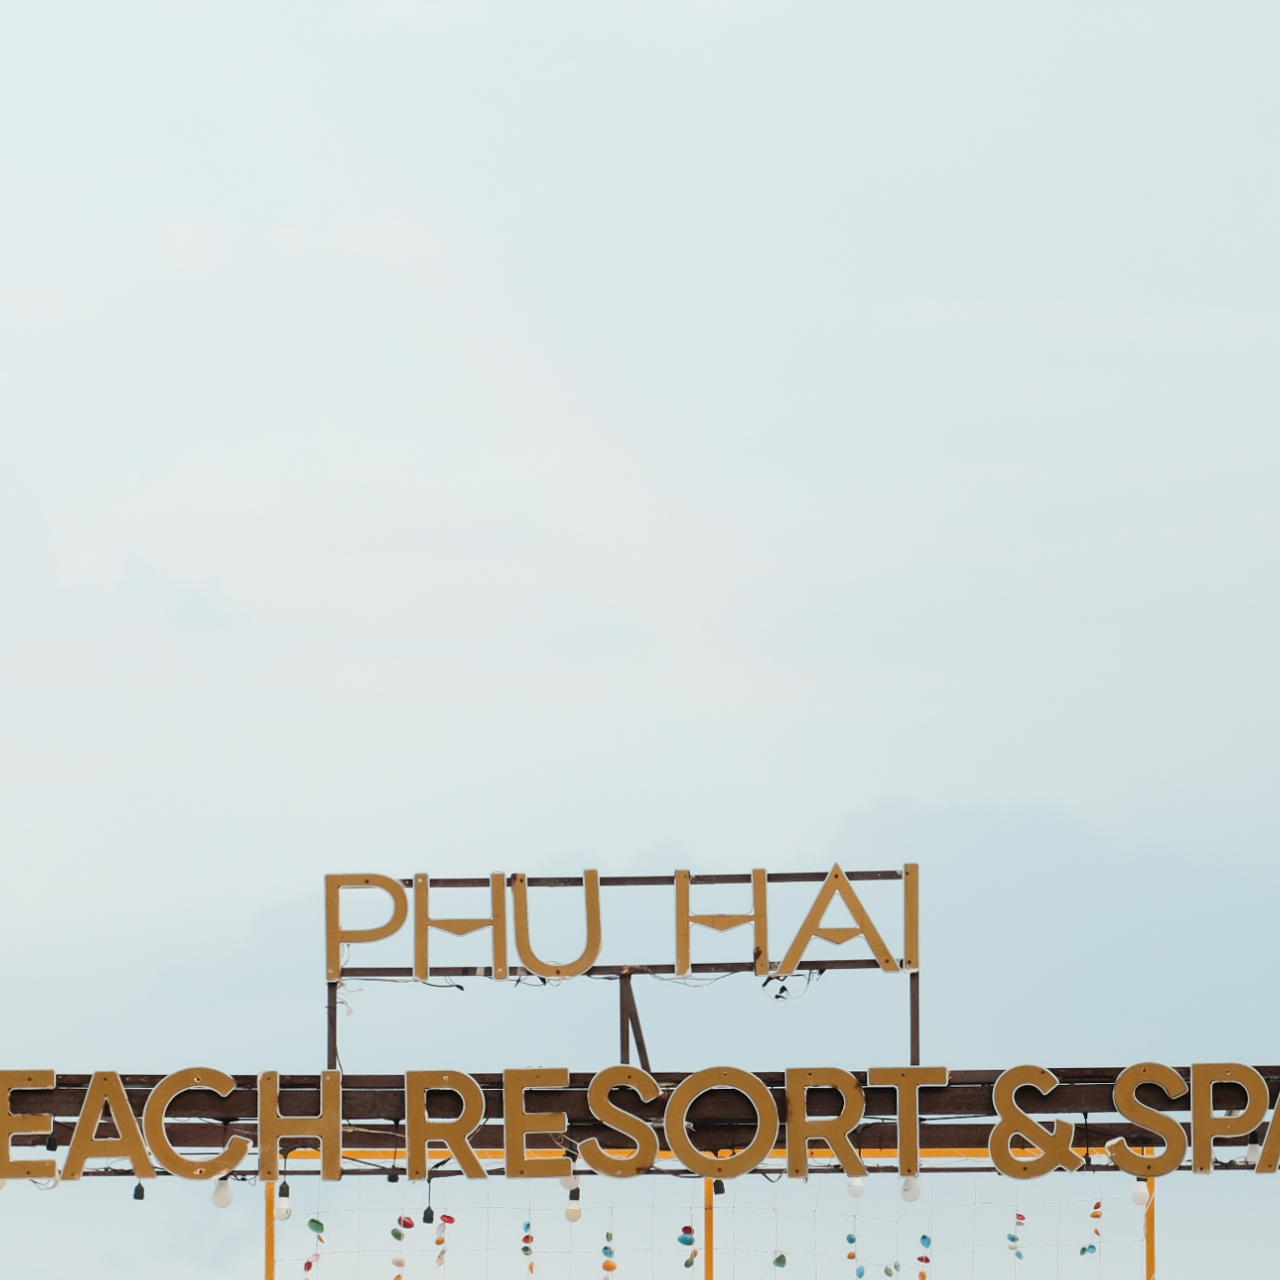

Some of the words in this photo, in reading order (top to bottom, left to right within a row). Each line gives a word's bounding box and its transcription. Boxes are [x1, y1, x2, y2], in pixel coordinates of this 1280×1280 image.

[324, 869, 602, 982] PHU
[674, 863, 919, 977] HAI
[406, 1065, 950, 1180] RESORT
[988, 1064, 1085, 1179] &
